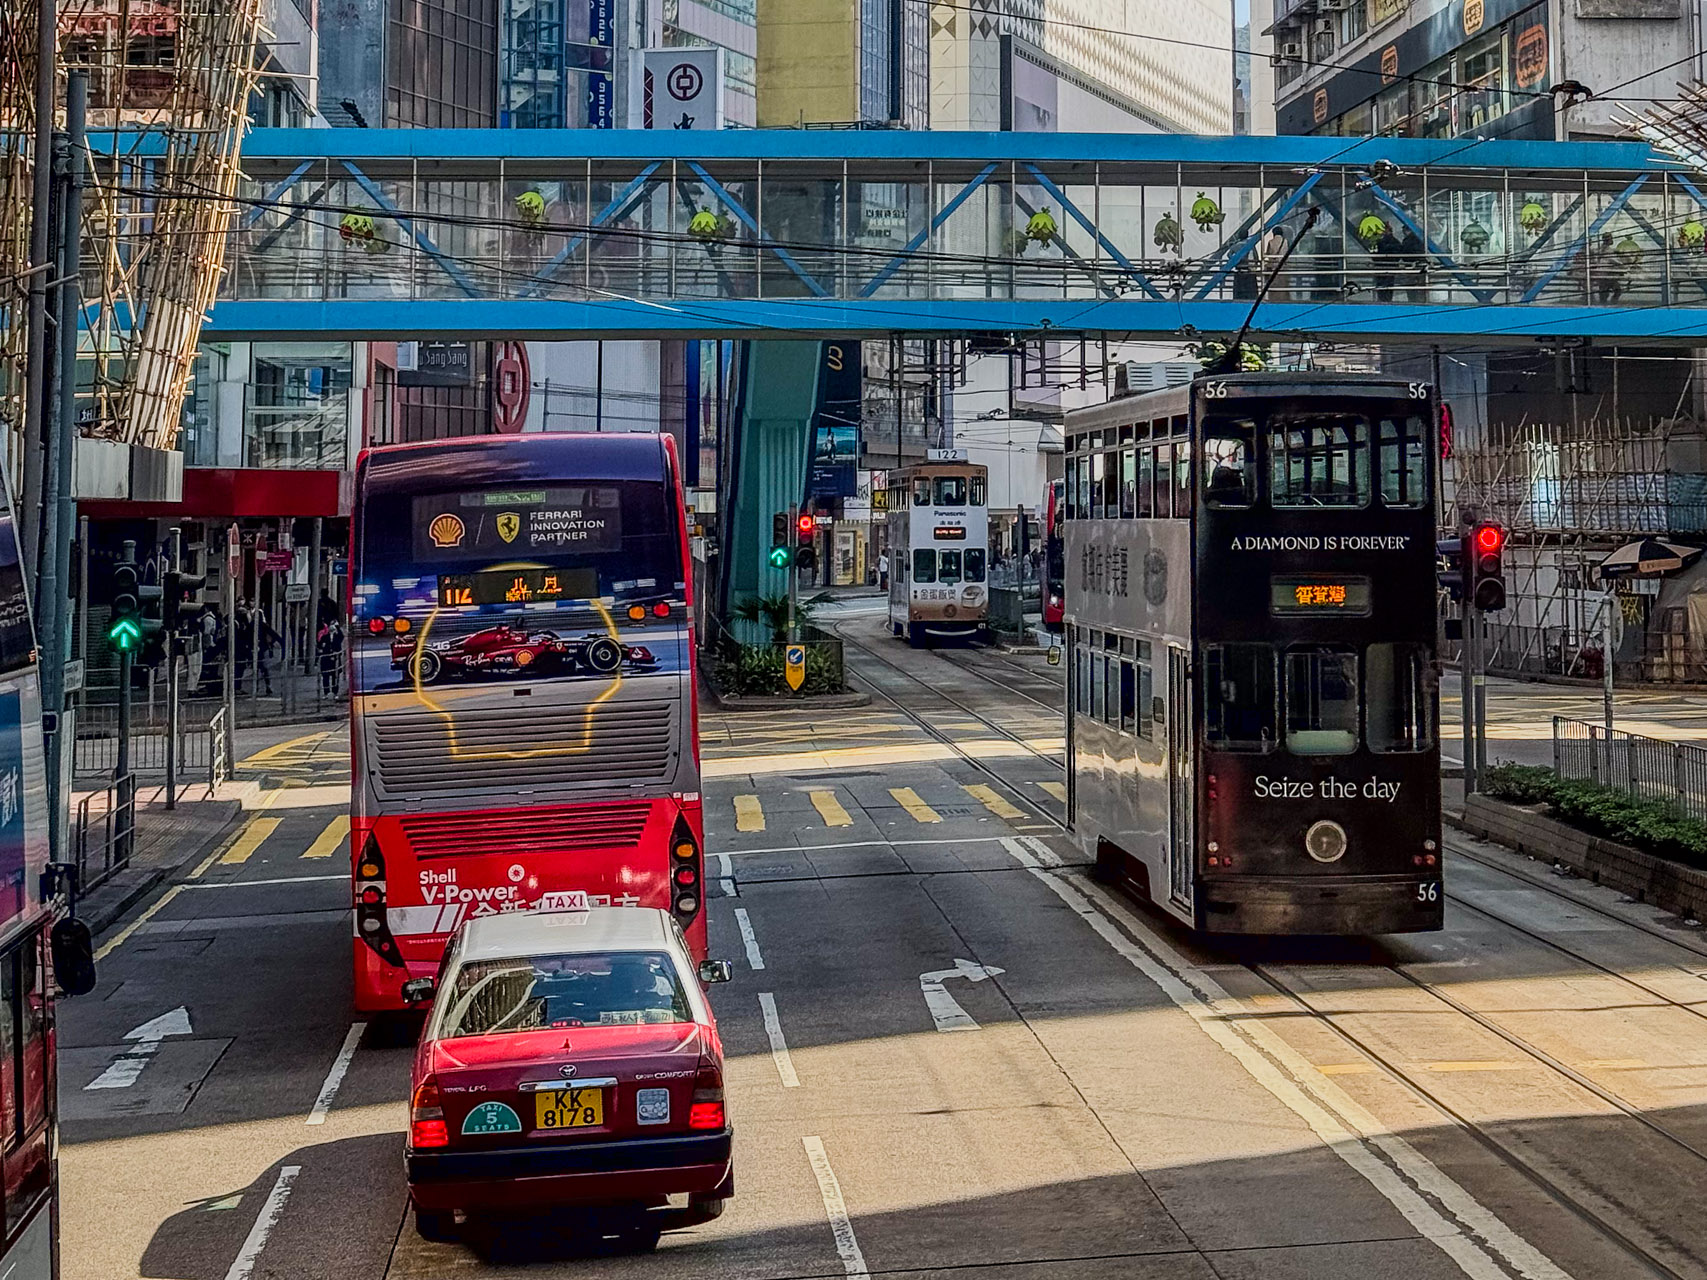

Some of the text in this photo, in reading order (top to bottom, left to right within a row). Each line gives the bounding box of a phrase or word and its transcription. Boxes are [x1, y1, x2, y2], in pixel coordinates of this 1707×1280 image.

[425, 350, 446, 368] Sang
[447, 350, 468, 368] Sang
[1205, 381, 1227, 399] 56
[1408, 383, 1427, 400] 56
[938, 450, 958, 459] 122
[529, 510, 583, 521] FERRARI
[529, 519, 606, 531] INNOVATION
[530, 531, 588, 543] PARTNER
[1231, 536, 1243, 551] A
[1244, 536, 1321, 551] DIAMOND
[1323, 536, 1338, 551] IS
[1254, 776, 1401, 802] Seize the day
[420, 868, 457, 885] Shell
[421, 885, 518, 905] V-Power
[1417, 883, 1437, 901] 56
[546, 895, 585, 910] TAXI
[554, 1089, 583, 1109] KK
[480, 1104, 503, 1112] TAXI
[486, 1112, 498, 1125] 5
[544, 1107, 596, 1128] 8178
